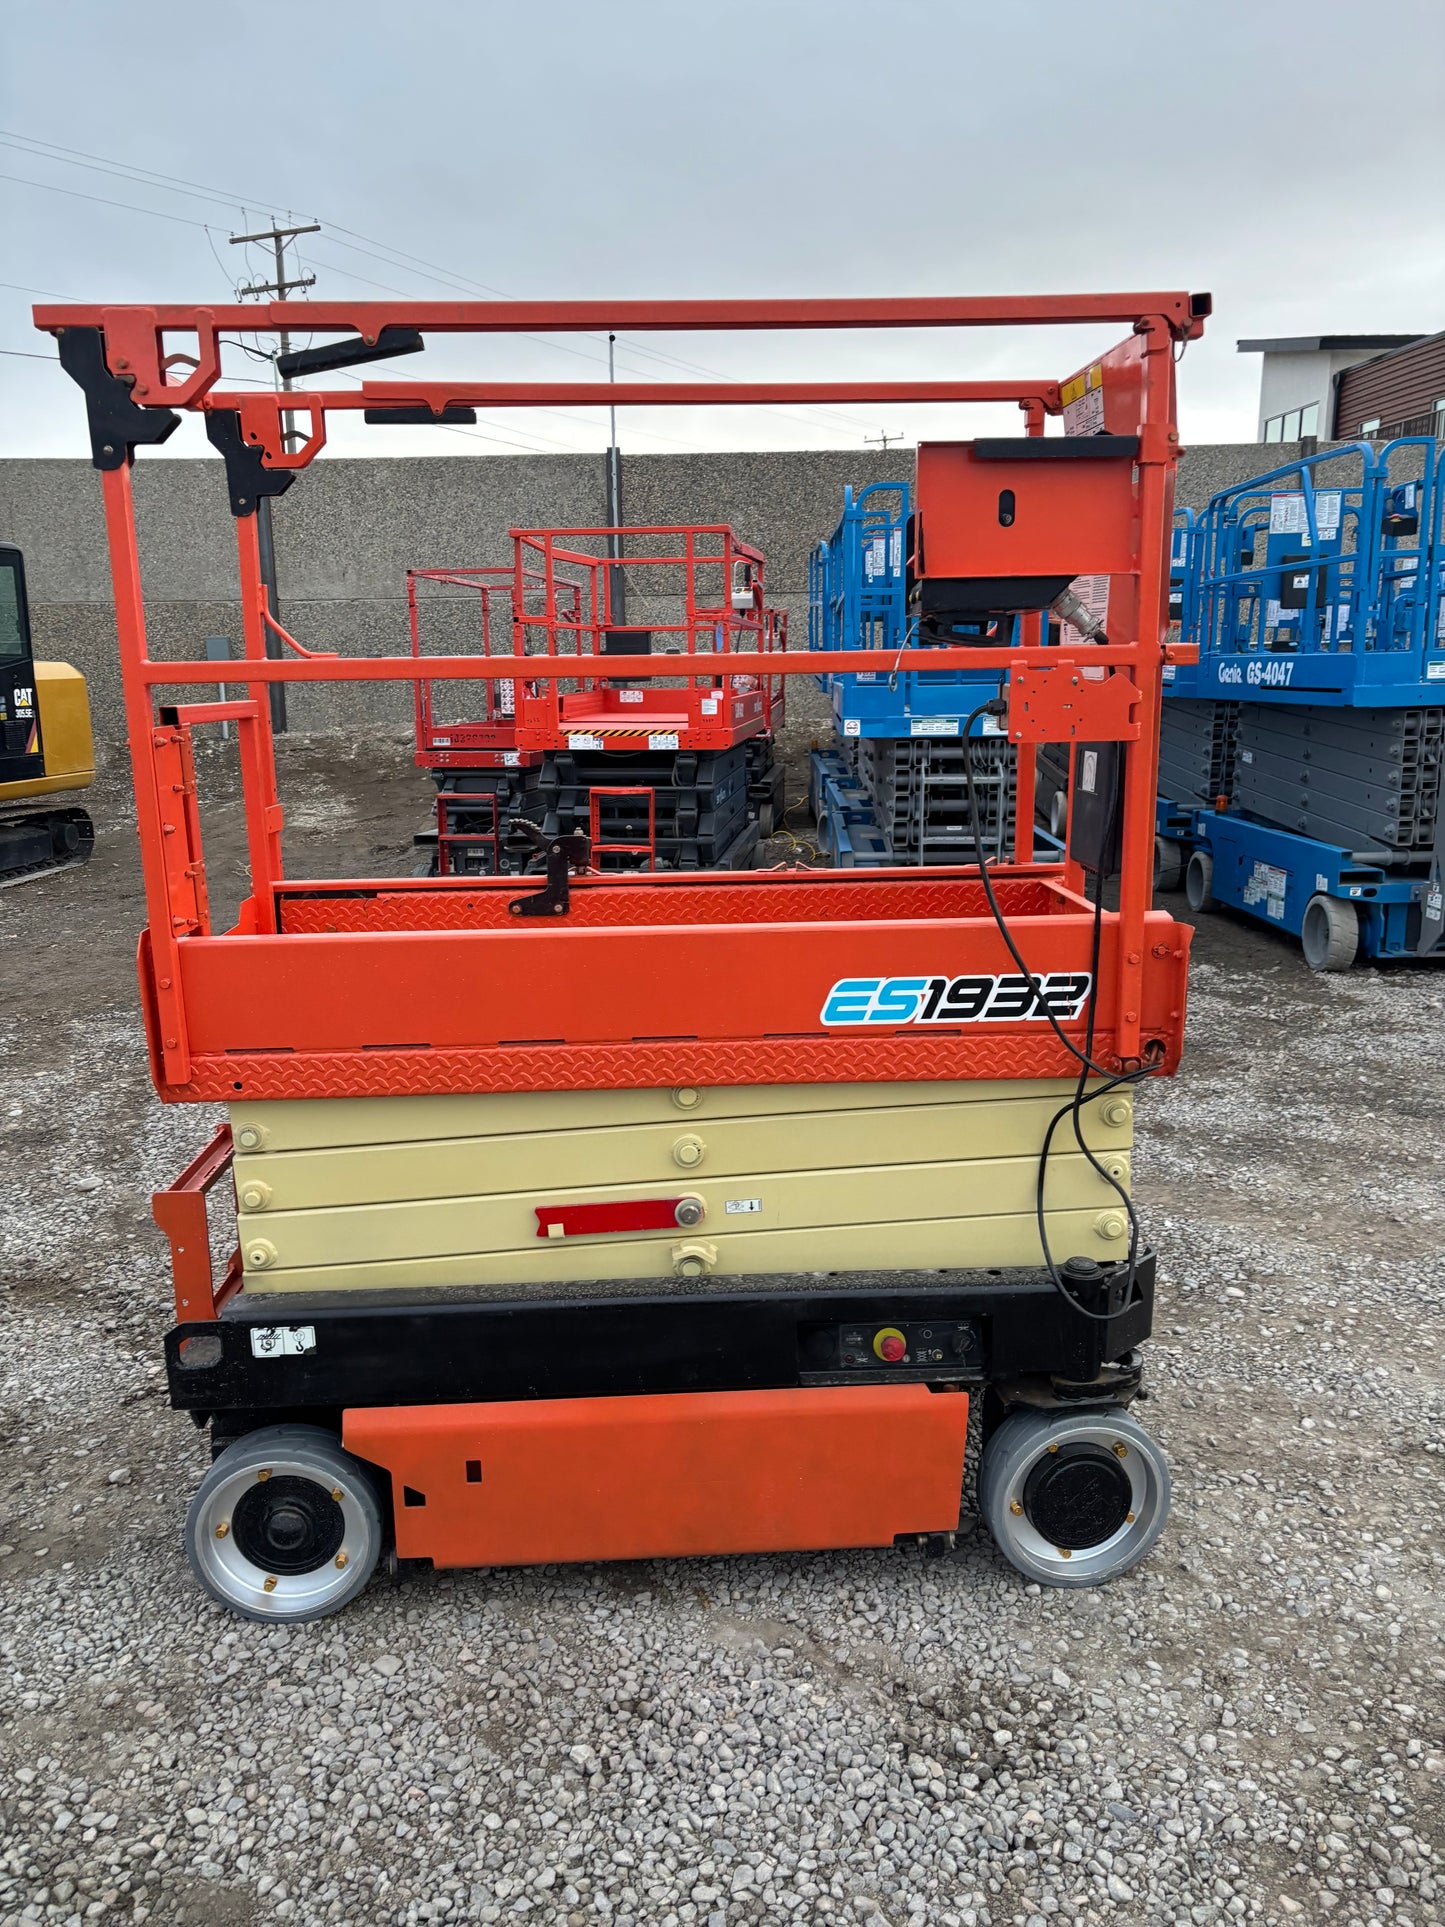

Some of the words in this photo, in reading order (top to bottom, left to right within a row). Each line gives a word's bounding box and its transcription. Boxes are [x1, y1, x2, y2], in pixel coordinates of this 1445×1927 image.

[1218, 662, 1243, 683] Genie
[1246, 661, 1295, 686] GS-4047
[13, 688, 33, 706] CAT
[821, 973, 1092, 1025] ES1932
